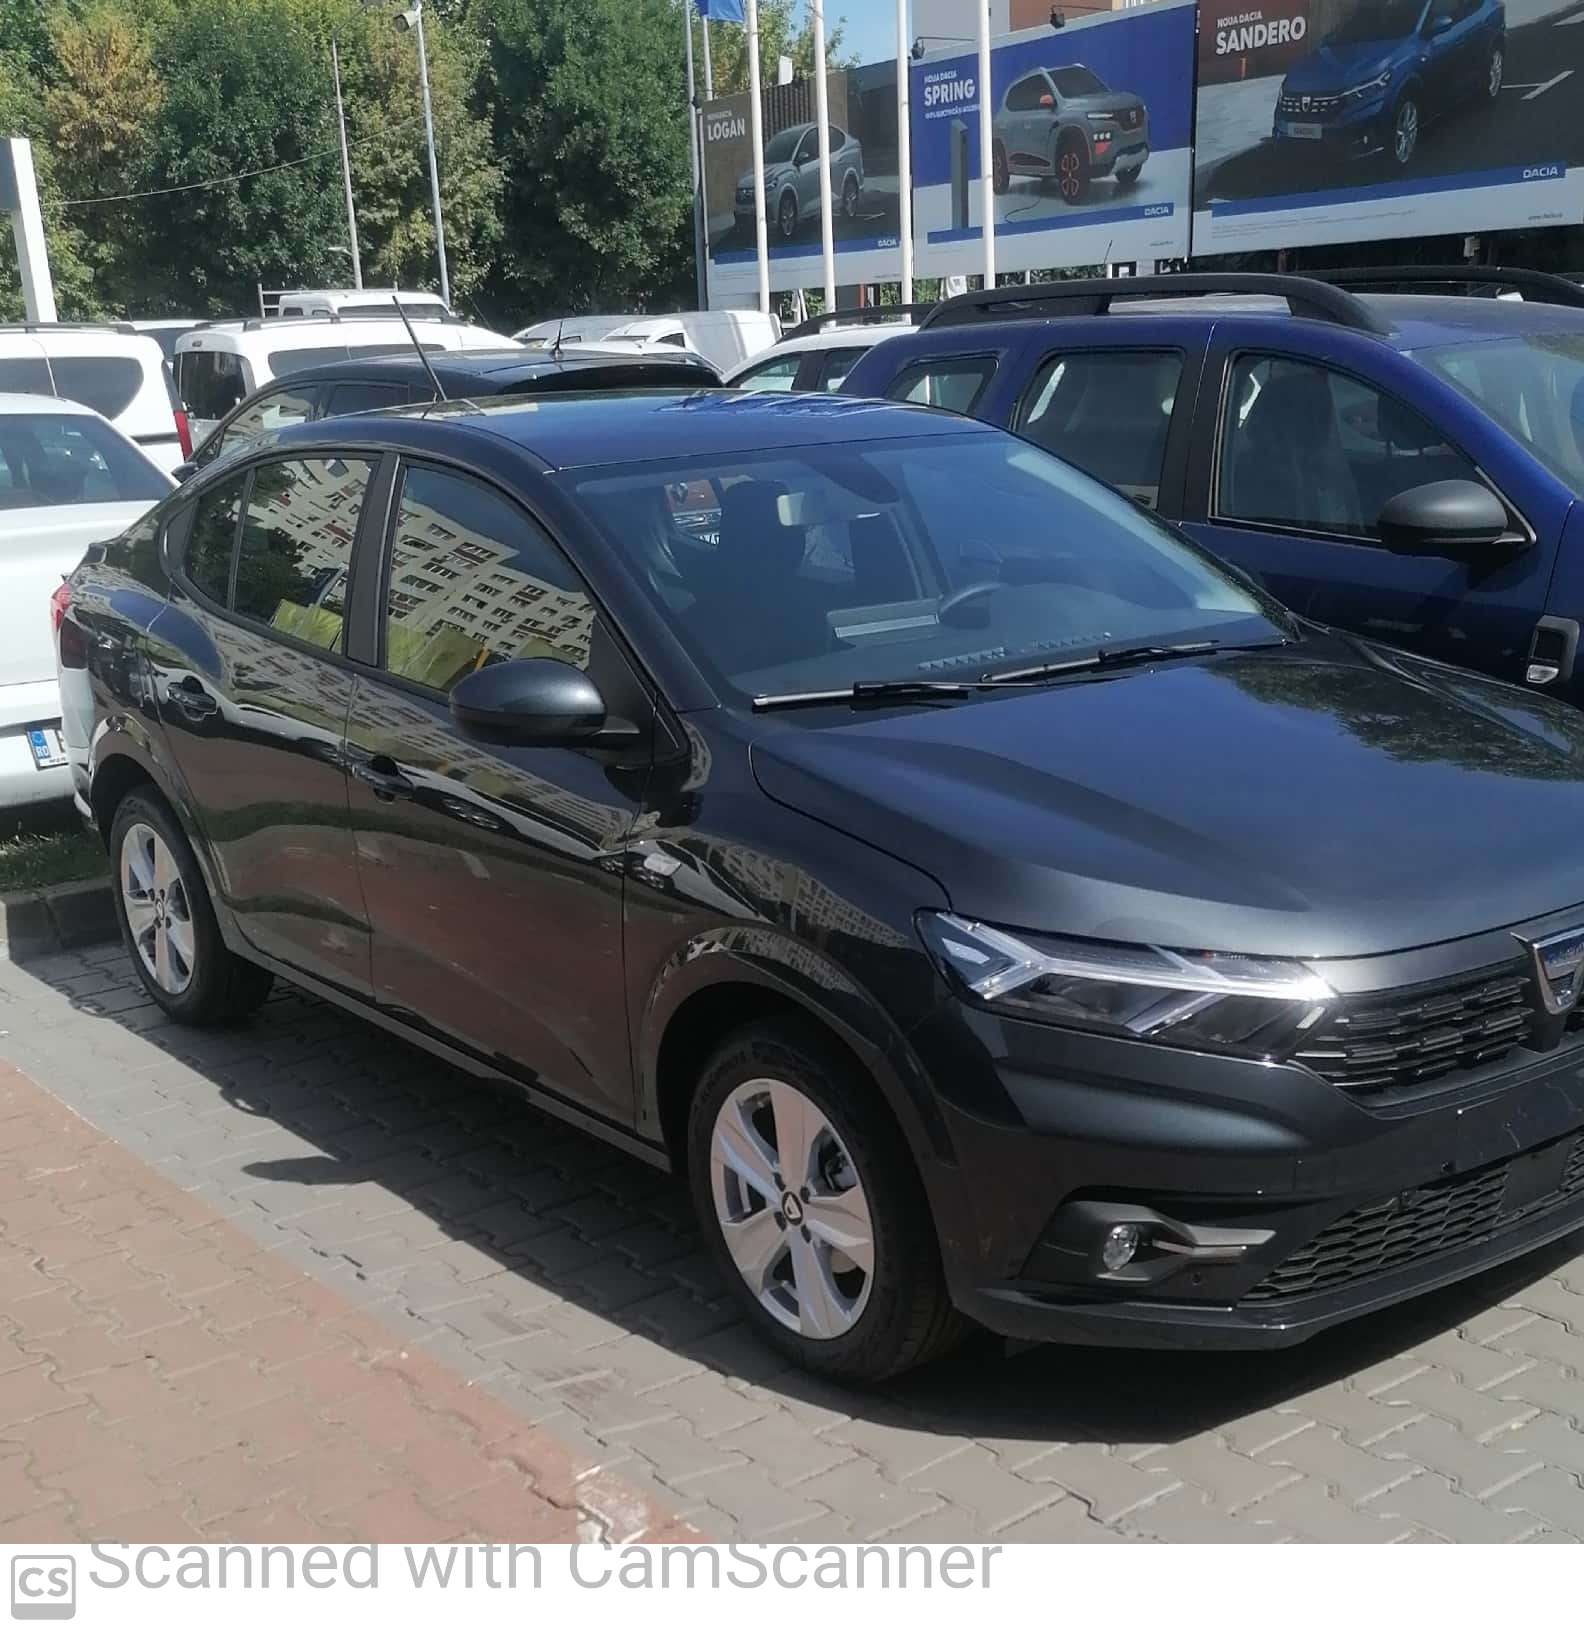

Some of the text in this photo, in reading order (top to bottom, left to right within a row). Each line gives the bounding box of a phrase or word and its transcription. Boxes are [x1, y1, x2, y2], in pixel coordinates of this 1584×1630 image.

[1217, 10, 1262, 28] NOUA DACIA
[1216, 16, 1306, 55] SANDERO
[924, 78, 975, 106] SPRING
[708, 117, 745, 141] LOGAN
[1523, 166, 1558, 178] DACIA
[1144, 206, 1169, 216] DACIA
[877, 238, 897, 247] DACIA
[36, 745, 49, 757] RO
